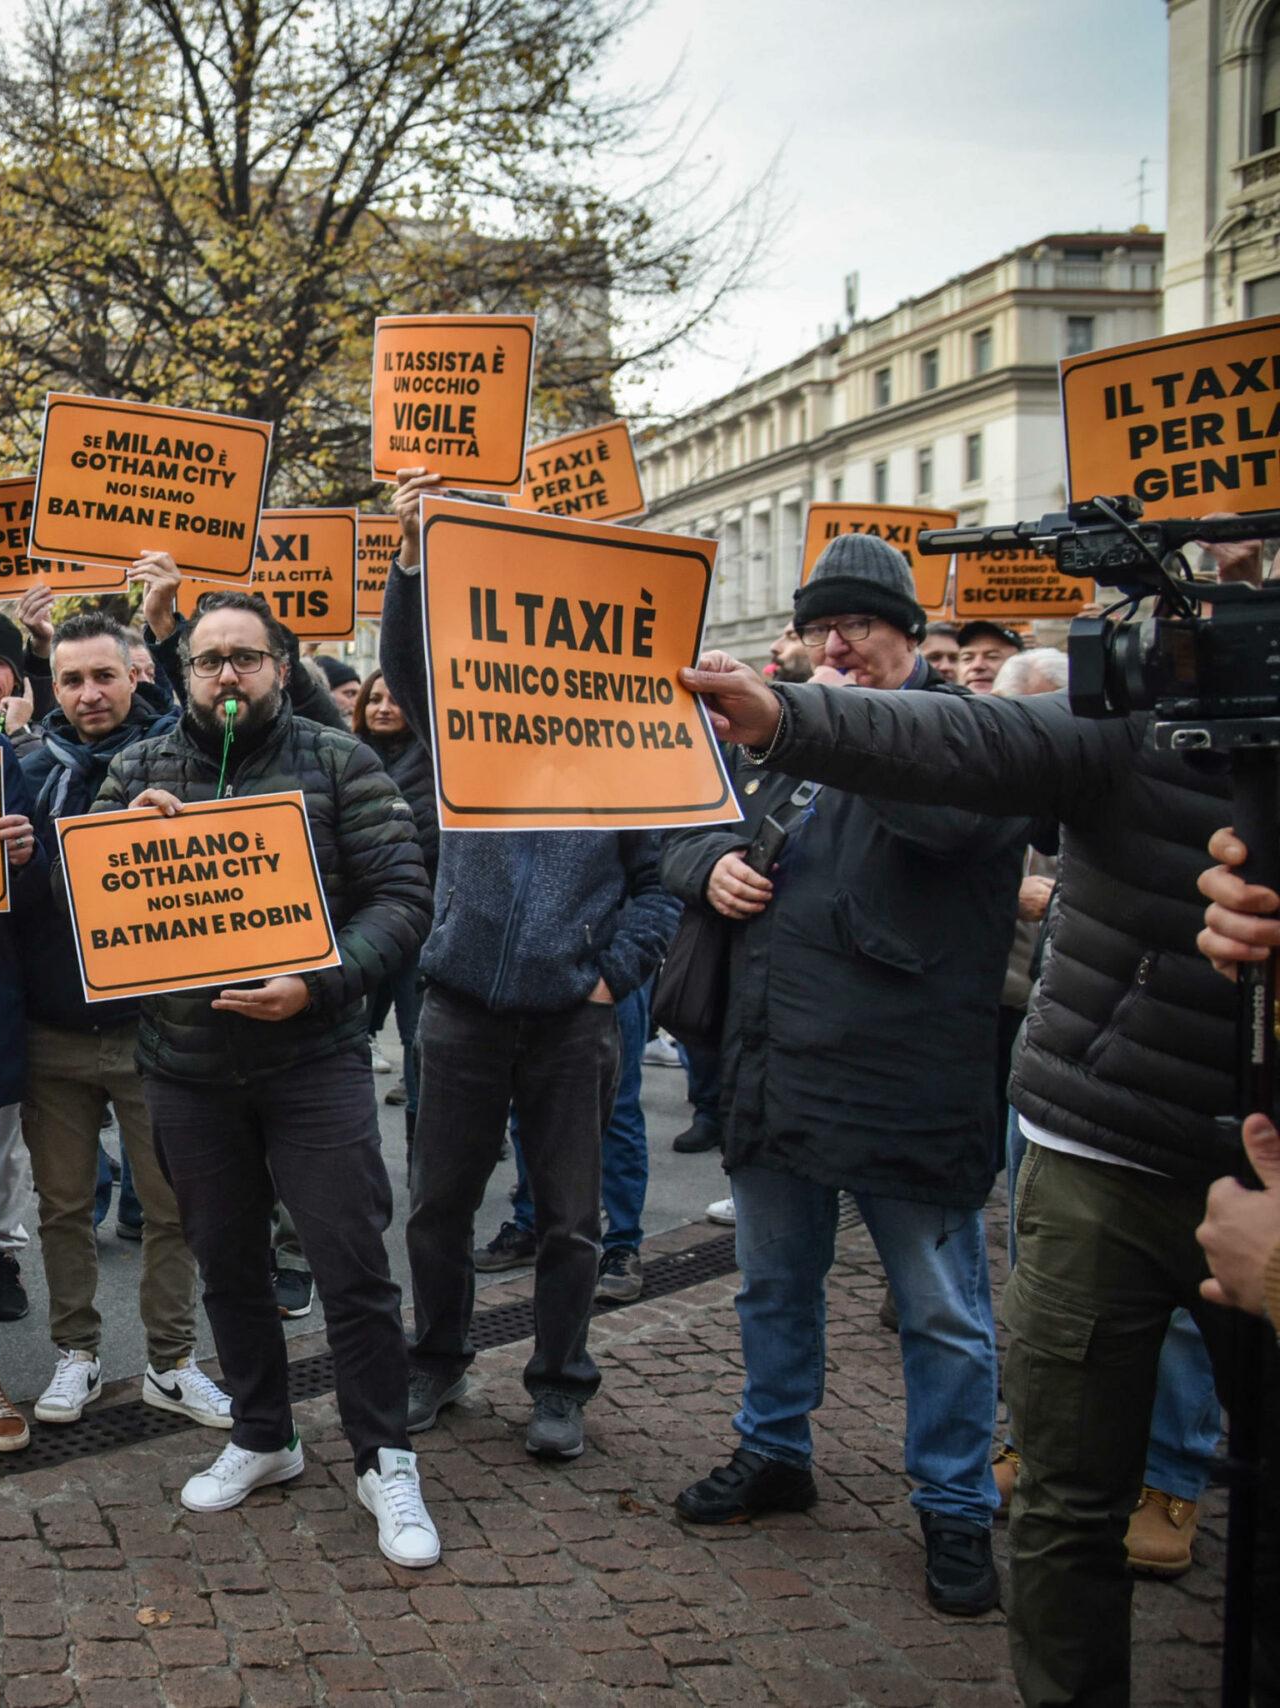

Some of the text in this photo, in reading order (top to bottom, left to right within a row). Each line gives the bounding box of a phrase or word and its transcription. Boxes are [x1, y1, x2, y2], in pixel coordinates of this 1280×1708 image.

[385, 346, 505, 374] IL TASSISTA È
[394, 377, 480, 395] UN OCCHIO
[1104, 354, 1280, 420] IL TAXI
[394, 403, 476, 434] VIGILE
[1128, 413, 1224, 460] PER
[84, 430, 227, 466] SE MILANO È
[390, 434, 479, 458] SULLA CITTÀ
[524, 440, 610, 484] L TAXI È
[71, 451, 236, 488] GOTHAM CITY
[532, 469, 604, 502] PER LA
[1134, 450, 1280, 502] GENT
[0, 500, 33, 522] TA
[106, 482, 194, 504] NOI SIAMO
[48, 497, 245, 540] BATMAN E ROBIN
[268, 571, 286, 582] LA
[289, 567, 332, 581] CITTÀ
[963, 587, 1083, 602] SICUREZZA
[470, 587, 656, 658] IL TAXI È
[451, 658, 673, 704] L'UNICO SERVIZIO
[448, 709, 692, 749] DI TRASPORTO H24
[108, 832, 265, 867] SE MILANO È
[102, 853, 280, 892] GOTHAM CITY
[148, 888, 244, 912] NOI SIAMO
[91, 903, 312, 949] BATMAN E ROBIN
